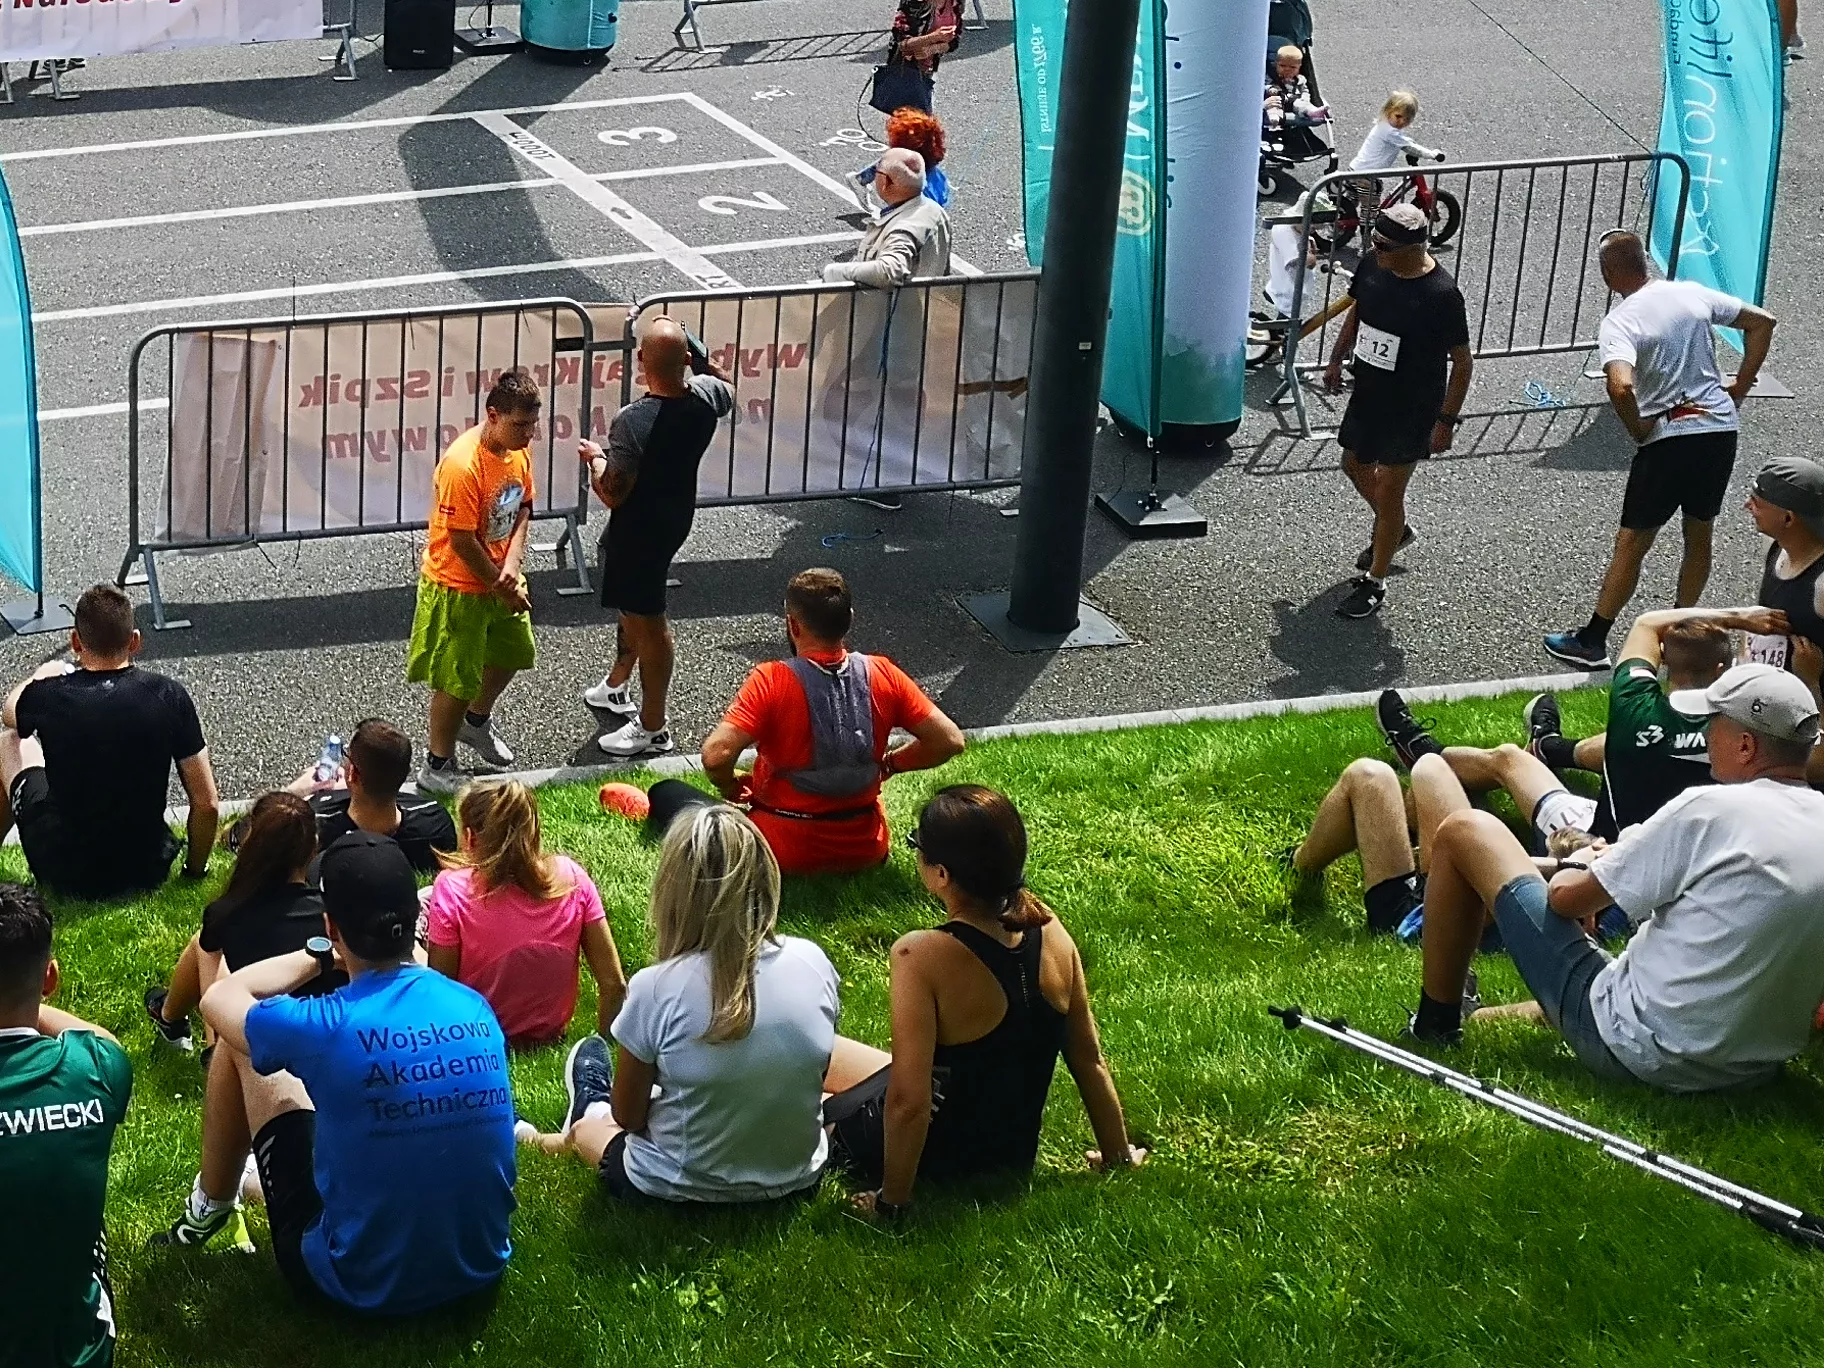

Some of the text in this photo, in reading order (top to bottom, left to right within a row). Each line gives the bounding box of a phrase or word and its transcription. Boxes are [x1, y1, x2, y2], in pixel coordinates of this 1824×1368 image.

[597, 126, 678, 147] 3
[697, 190, 790, 215] 2
[1372, 340, 1389, 358] 12
[357, 1022, 491, 1053] Wojskowa
[364, 1048, 500, 1089] Akademia
[365, 1087, 508, 1122] Techniczna
